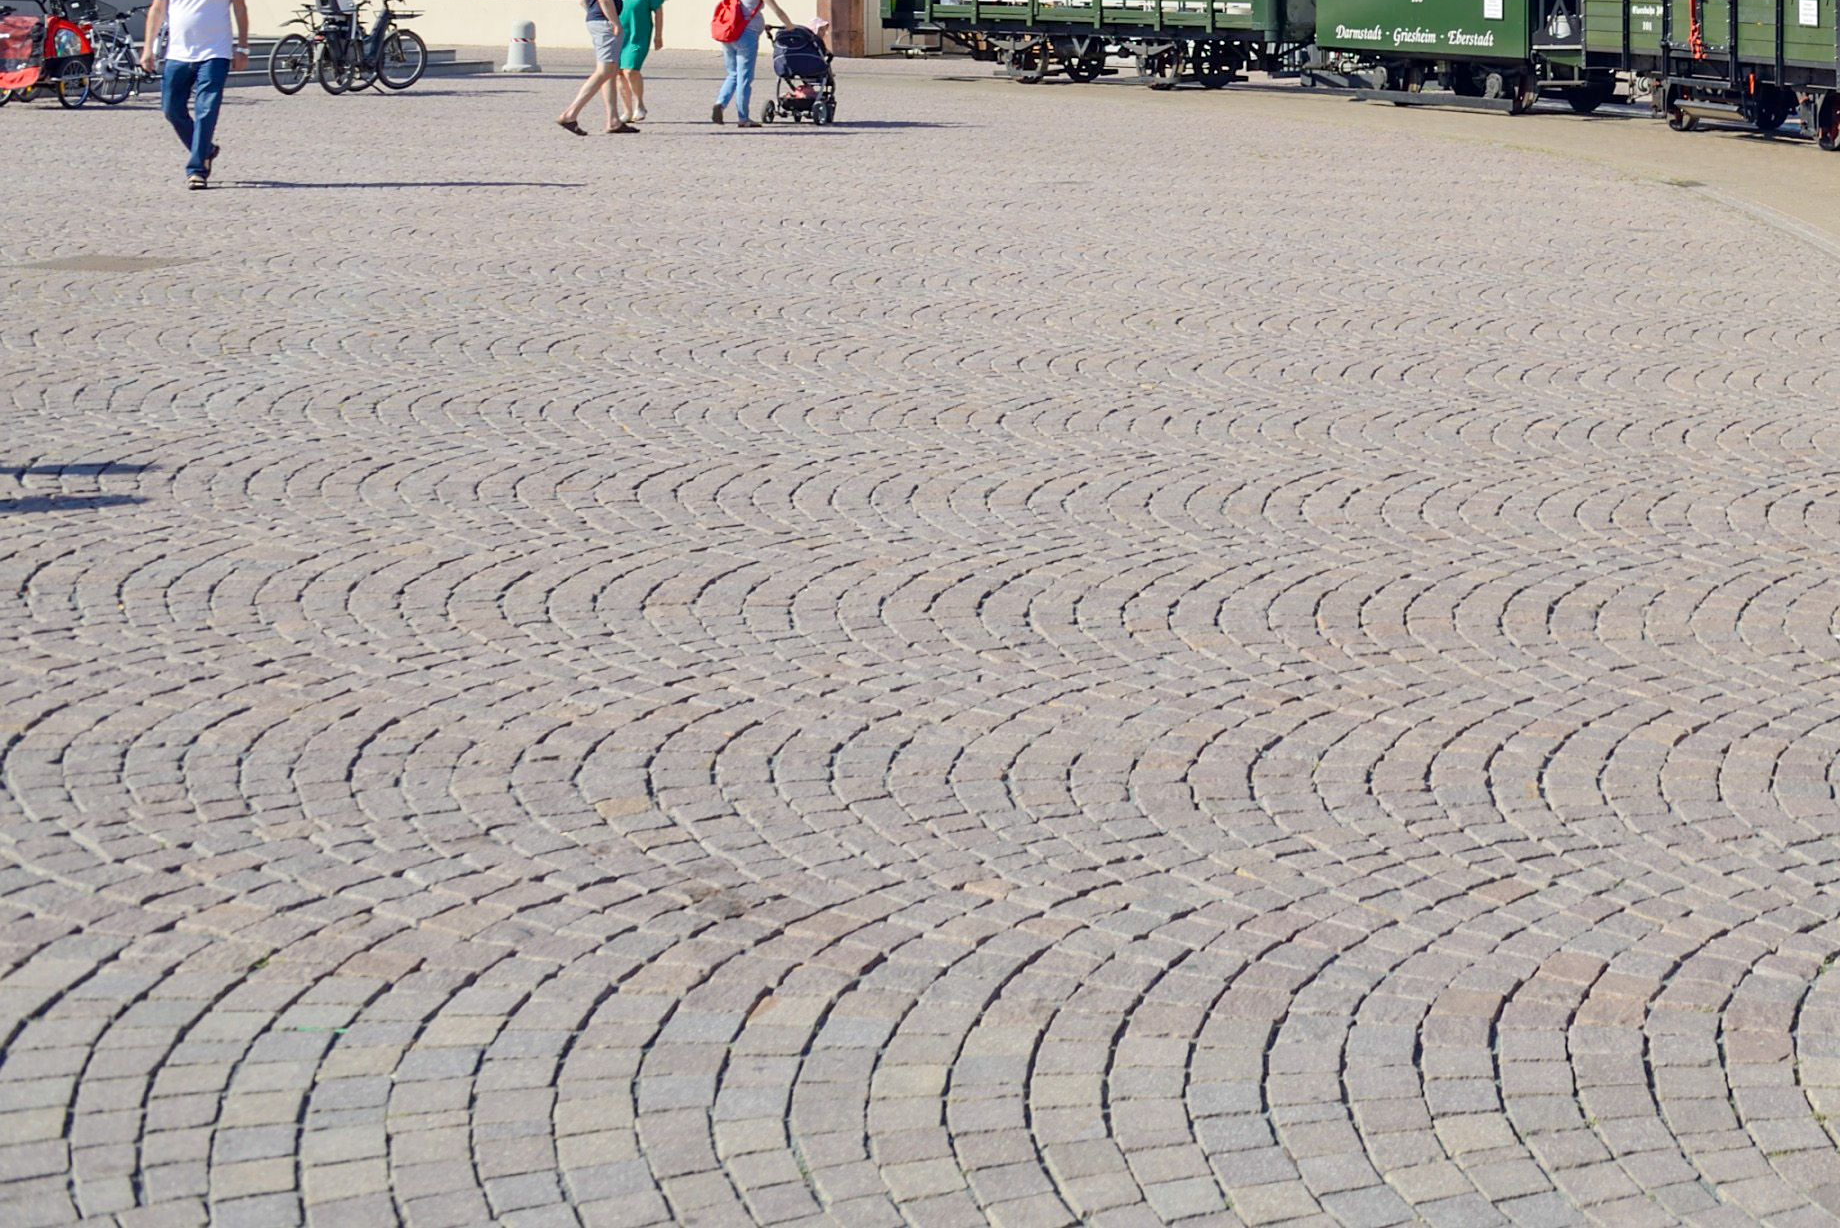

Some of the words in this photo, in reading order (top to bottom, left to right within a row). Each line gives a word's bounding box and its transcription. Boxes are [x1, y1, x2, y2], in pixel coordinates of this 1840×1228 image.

[1335, 24, 1382, 41] Darmstadt
[1393, 27, 1437, 47] Griesheim
[1447, 28, 1494, 47] Eberstadt
